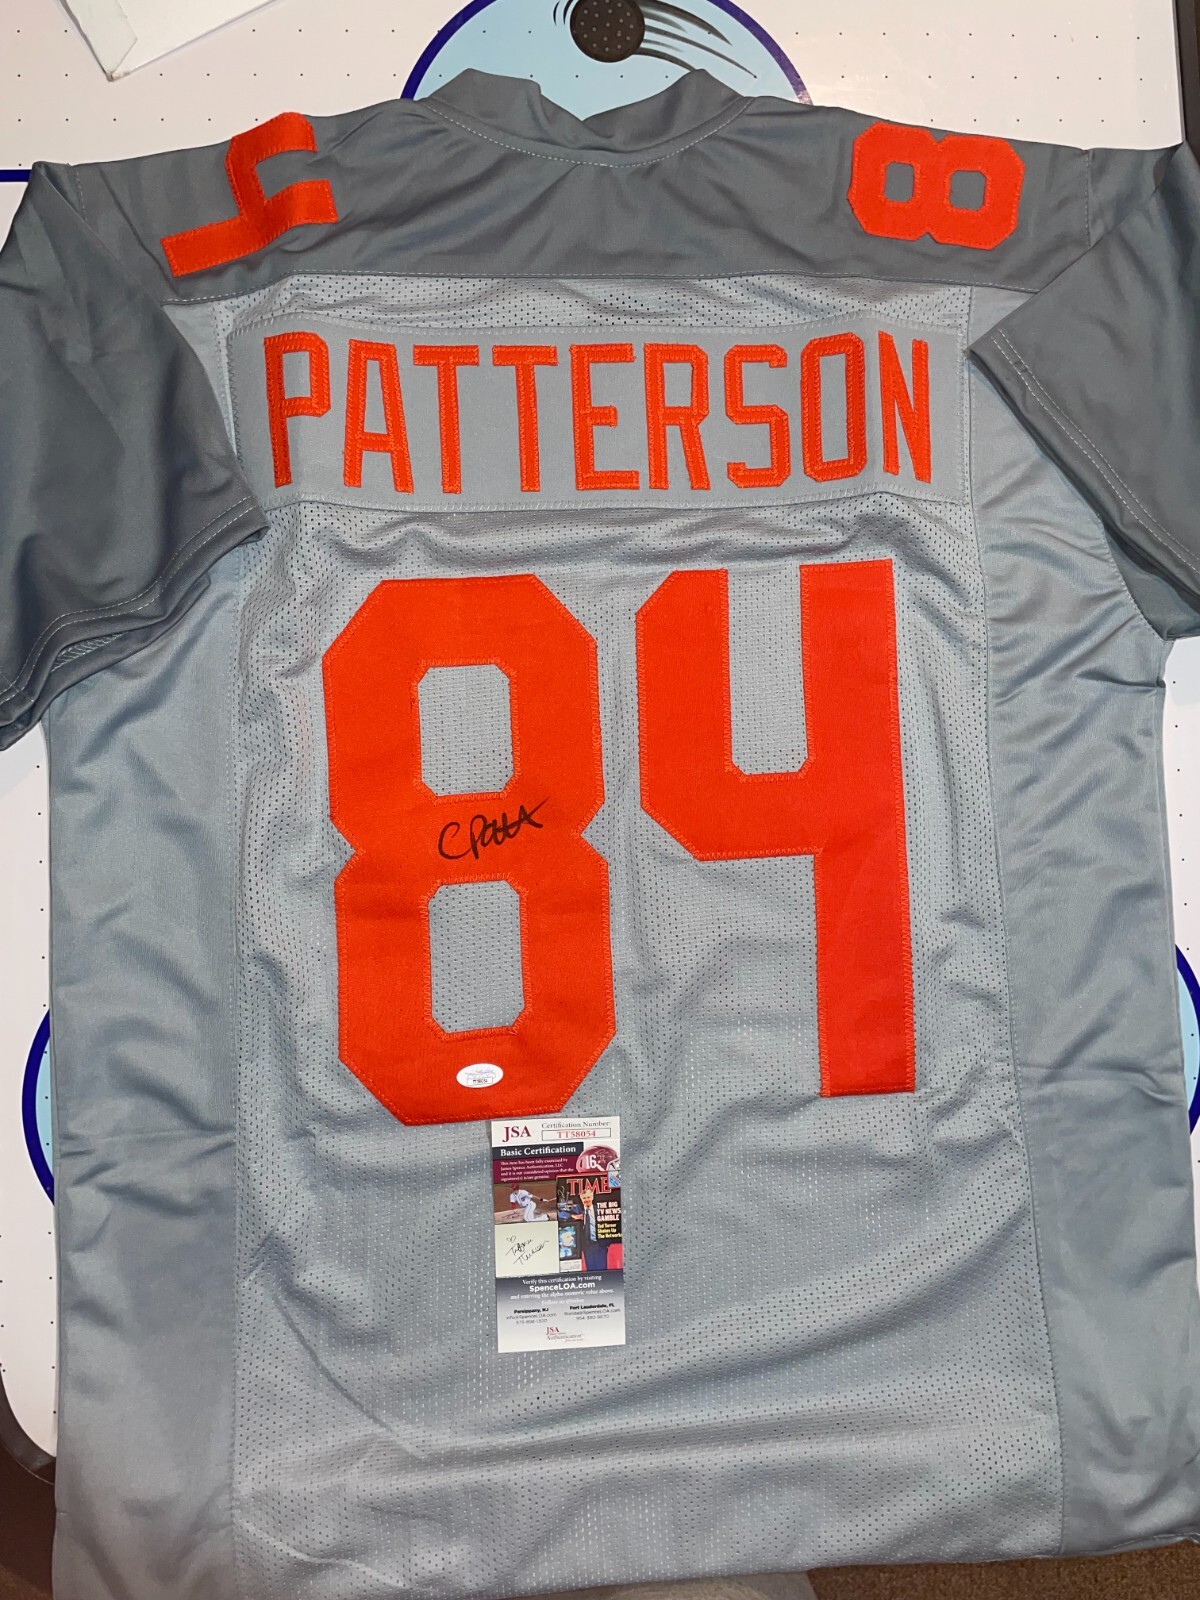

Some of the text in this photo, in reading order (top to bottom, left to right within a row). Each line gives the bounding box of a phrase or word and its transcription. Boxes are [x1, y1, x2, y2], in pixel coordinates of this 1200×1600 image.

[847, 122, 1025, 250] 8
[263, 331, 931, 494] PATTERSON
[322, 558, 915, 1126] 84
[541, 1121, 581, 1129] Certification
[502, 1125, 531, 1142] JSA
[556, 1130, 596, 1139] TT58054
[500, 1145, 576, 1157] Basic Certification
[585, 1155, 598, 1169] 16
[566, 1176, 611, 1196] TIME
[529, 1281, 596, 1293] SpenceLOA.com
[545, 1326, 560, 1335] JSA
